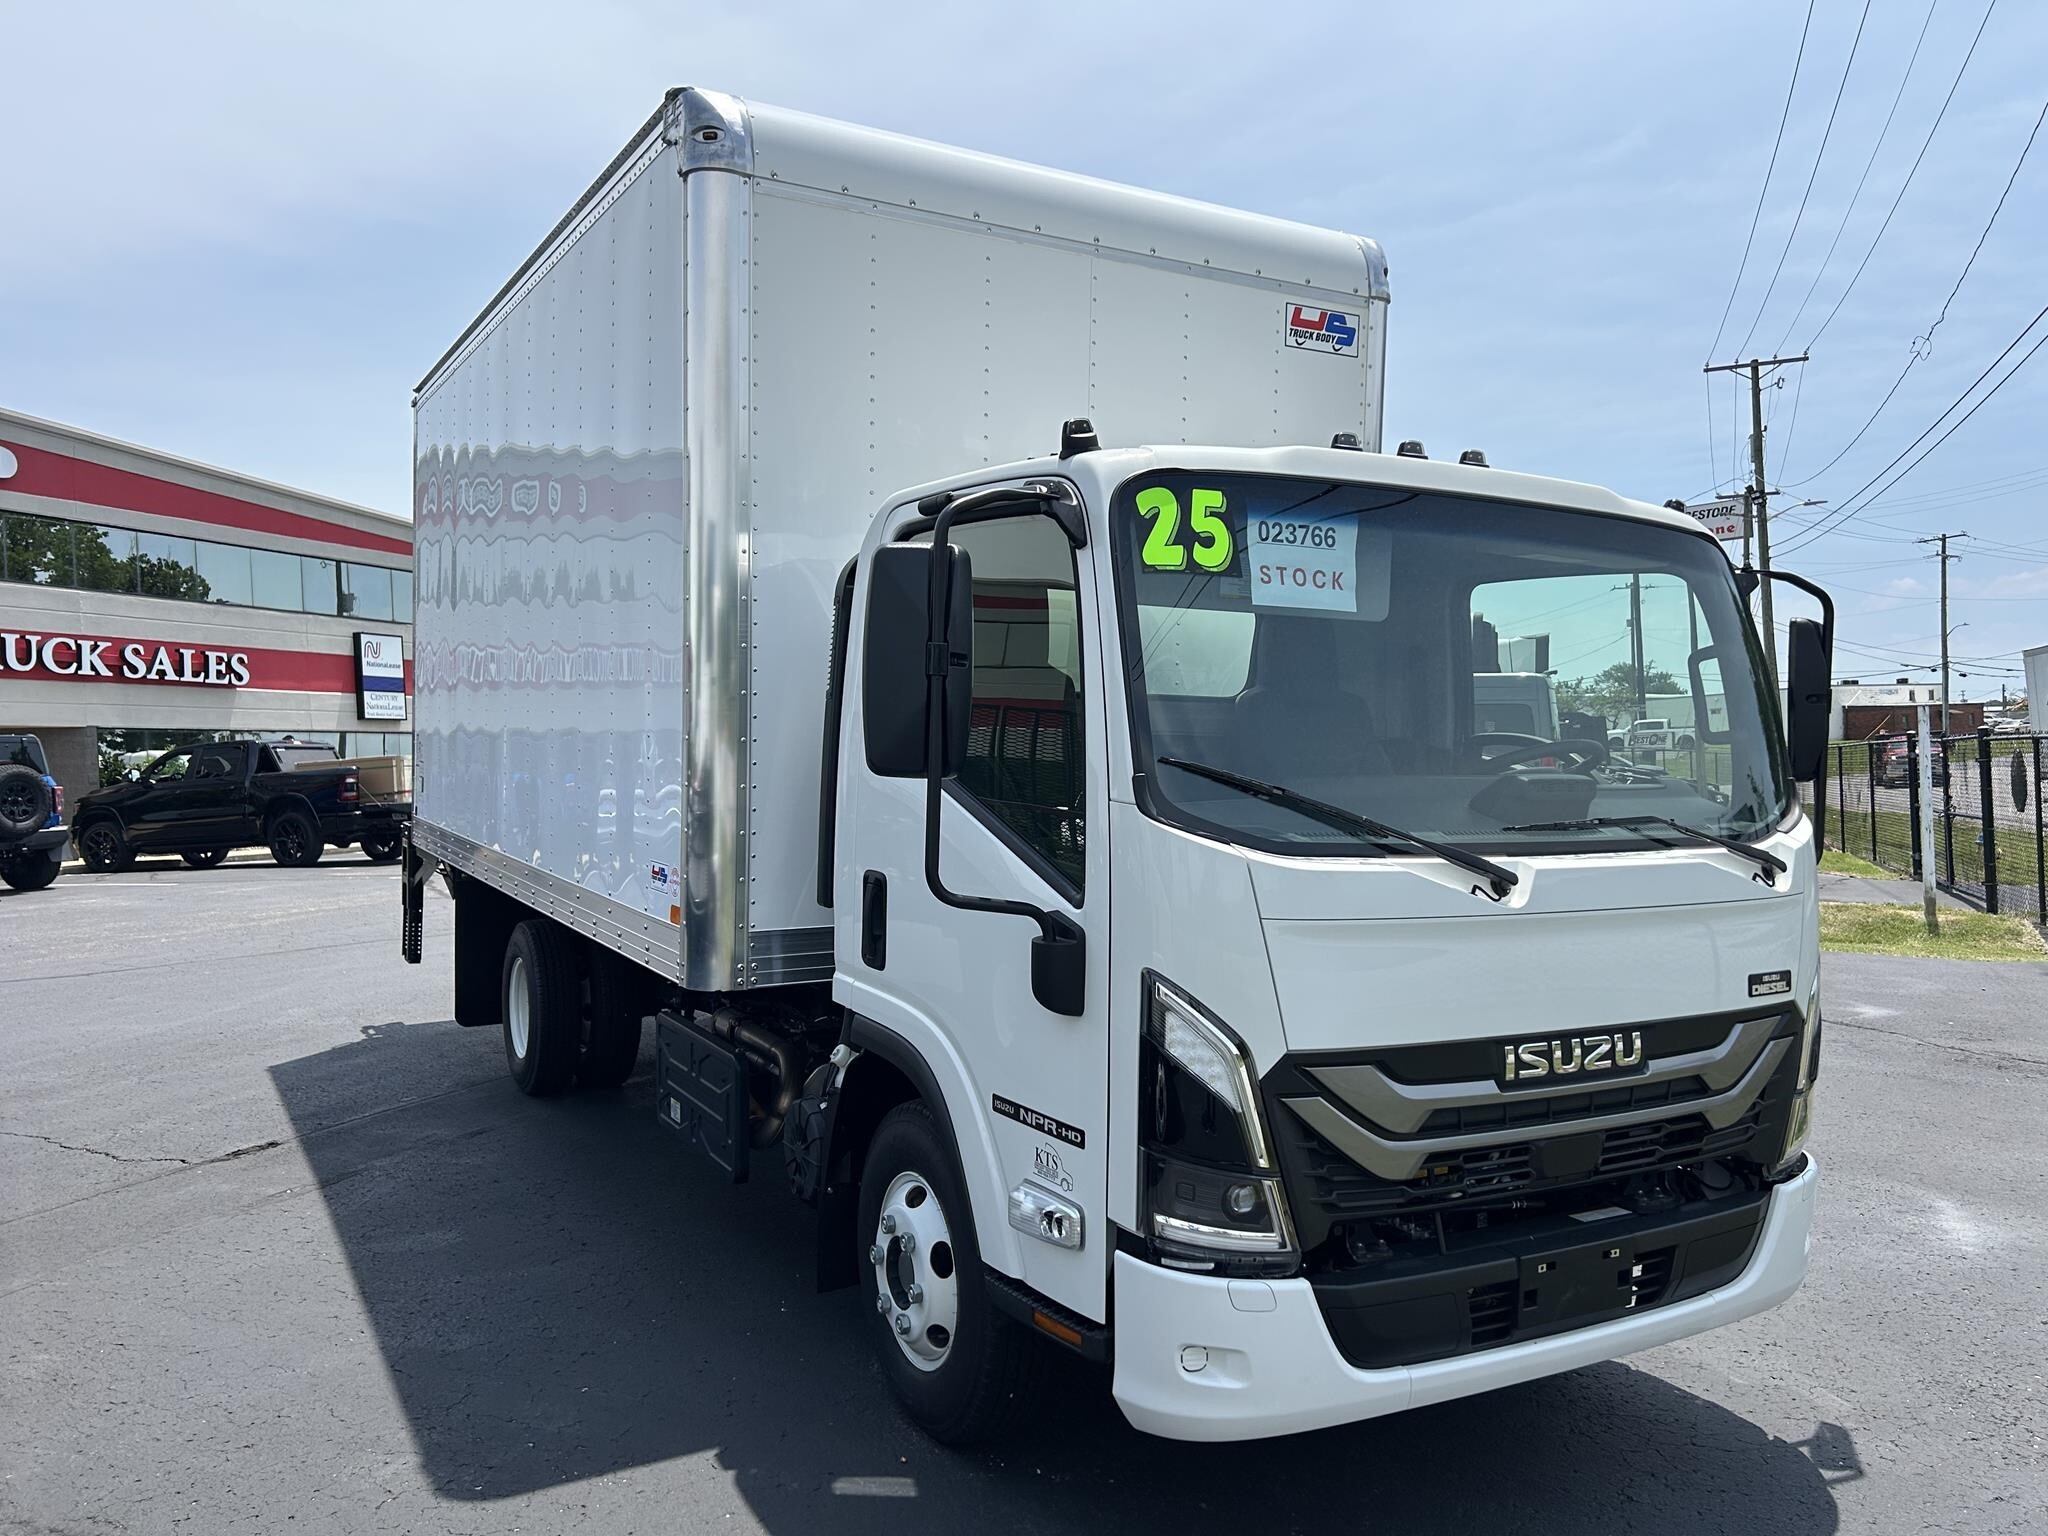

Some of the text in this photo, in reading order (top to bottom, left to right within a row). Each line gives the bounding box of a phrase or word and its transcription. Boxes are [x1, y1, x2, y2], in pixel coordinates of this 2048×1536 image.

[1289, 328, 1336, 344] TRUCK BODY
[1291, 306, 1357, 347] US
[1135, 486, 1234, 573] 25
[1257, 520, 1337, 548] 023766
[1259, 564, 1344, 591] STOCK
[0, 633, 251, 686] UCK SALES
[1752, 981, 1790, 996] DIESEL
[1762, 974, 1780, 982] ISUZU
[1504, 1031, 1642, 1081] ISUZU
[994, 1100, 1015, 1114] ISUZU
[1035, 1146, 1059, 1171] KTS
